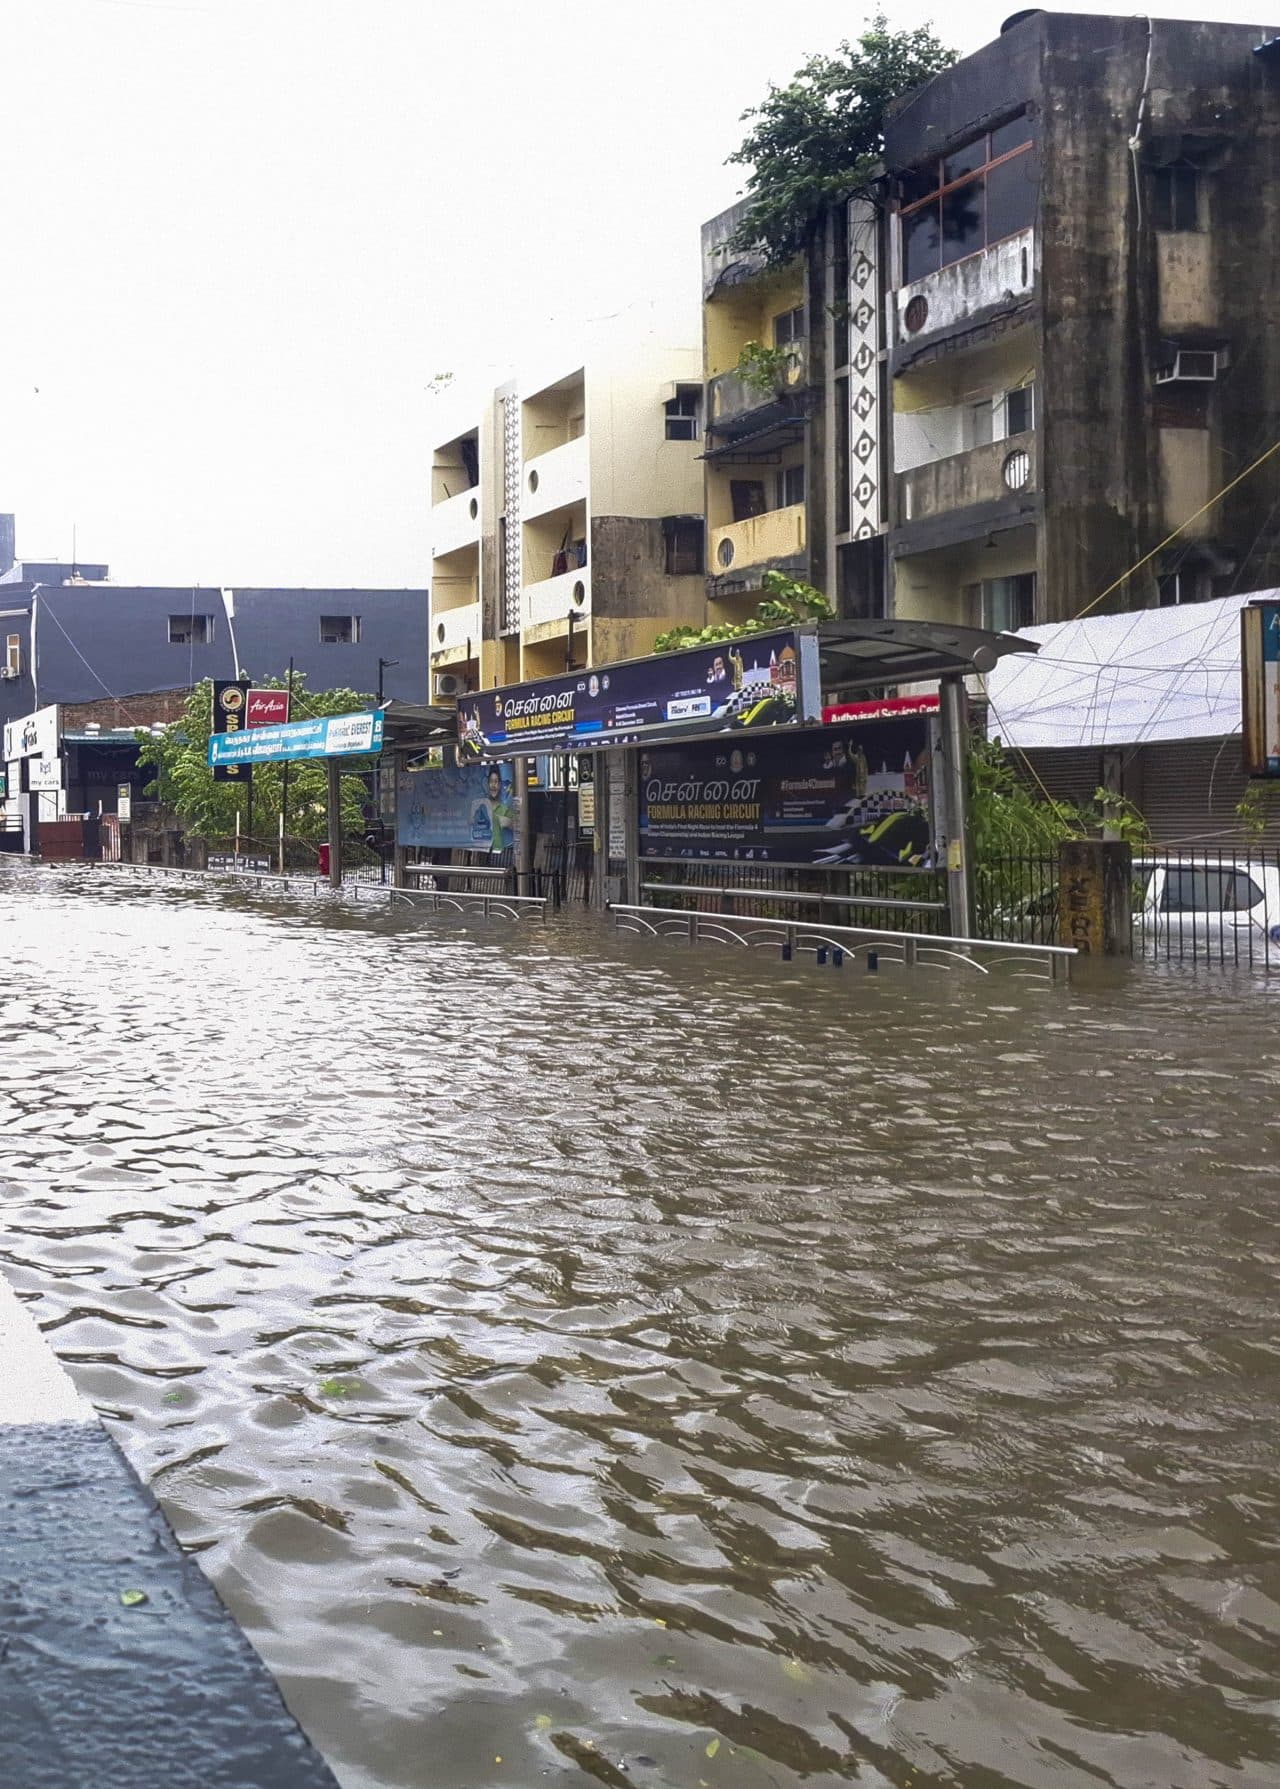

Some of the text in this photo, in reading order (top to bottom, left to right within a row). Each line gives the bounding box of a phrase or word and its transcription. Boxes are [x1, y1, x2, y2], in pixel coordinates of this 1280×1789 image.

[504, 691, 576, 718] சென்னை
[351, 722, 371, 736] EVEREST
[505, 709, 576, 731] FORMULA RACING CIRCUIT
[646, 775, 760, 801] சென்னை
[648, 803, 760, 819] FORMULA RACING CIRCUIT
